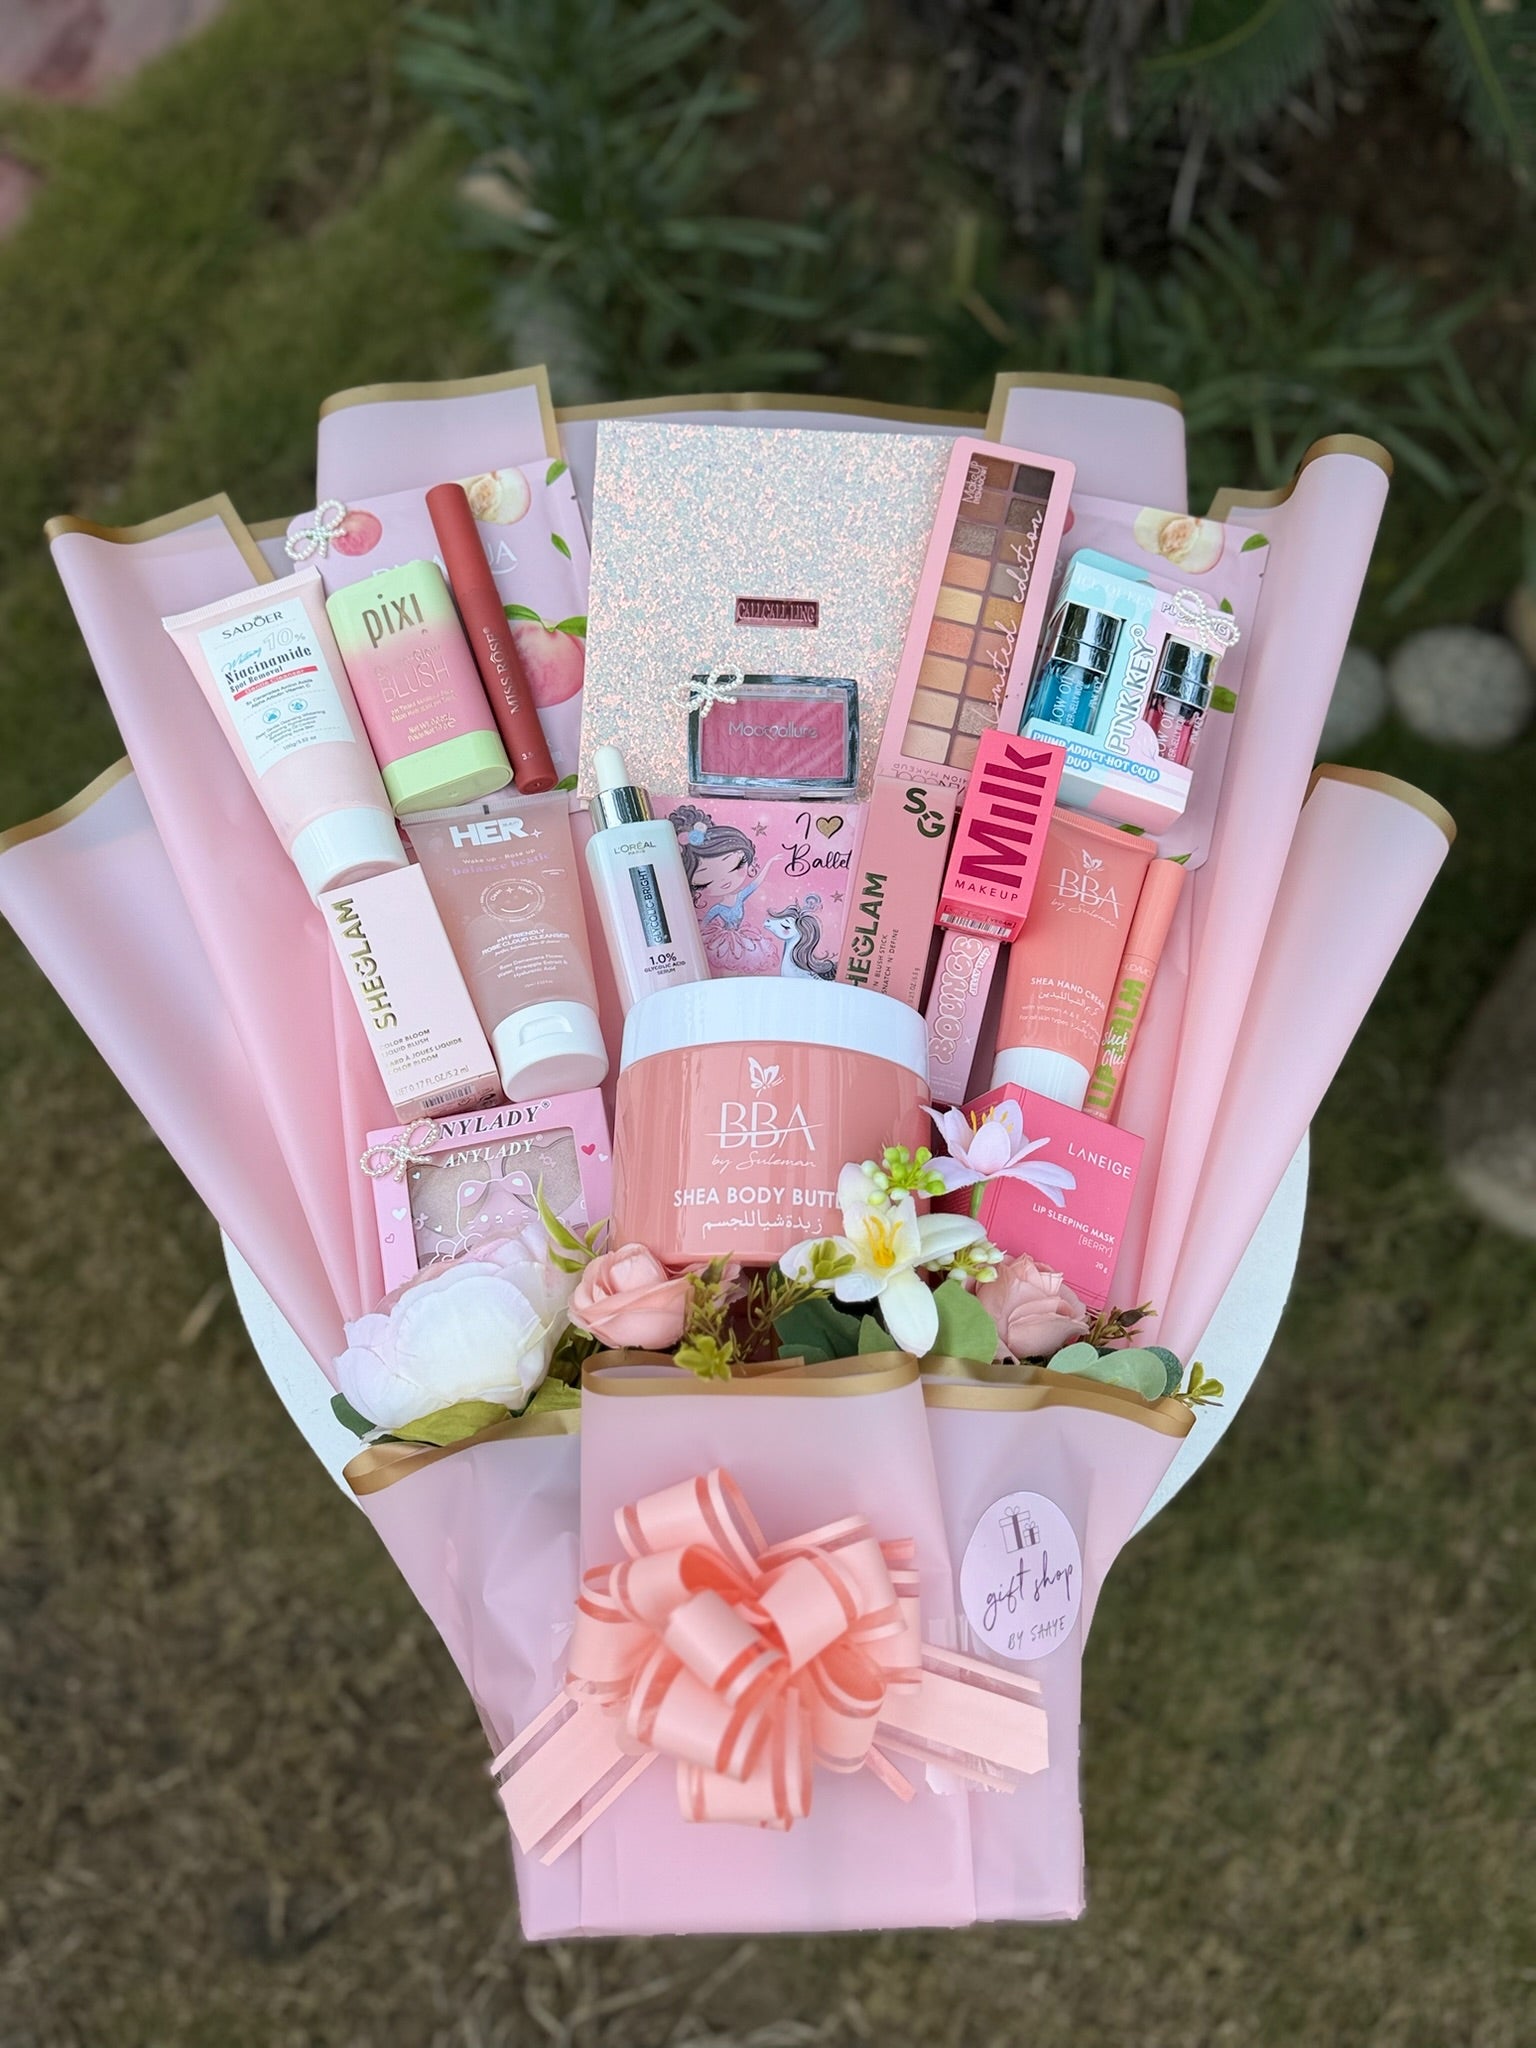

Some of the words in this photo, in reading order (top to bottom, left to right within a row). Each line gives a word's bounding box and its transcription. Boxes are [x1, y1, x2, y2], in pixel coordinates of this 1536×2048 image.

[1013, 510, 1042, 604] edition
[224, 646, 312, 686] Niacinamide
[378, 656, 450, 703] BLUSH
[499, 676, 520, 715] MISS
[1106, 691, 1143, 753] PINK
[1125, 637, 1156, 690] KEY
[1066, 756, 1090, 772] DUO
[1131, 761, 1159, 783] COLD
[448, 816, 529, 848] HER
[795, 811, 811, 840] I
[958, 743, 1053, 889] Milk
[781, 843, 853, 877] Ballet
[954, 879, 1018, 901] MAKEUP
[1056, 867, 1121, 919] BBA
[845, 872, 888, 987] HEGLAM
[878, 934, 888, 954] STICK
[889, 928, 899, 954] DEFINE
[331, 897, 398, 1032] SHEGLAM
[644, 962, 671, 973] GLYCOLIC
[649, 952, 677, 966] 1.0%
[1031, 977, 1054, 986] SHEA
[1057, 980, 1084, 994] HAND
[404, 1029, 430, 1041] BLOOM
[719, 1101, 816, 1151] BBA
[443, 1138, 534, 1169] ANYLADY
[711, 1153, 733, 1174] by
[1067, 1142, 1132, 1180] LANEIGE
[673, 1187, 720, 1208] SHEA
[727, 1186, 786, 1205] BODY
[1032, 1203, 1046, 1215] LIP
[1047, 1209, 1090, 1233] SLEEPING
[1090, 1225, 1116, 1245] MASK
[983, 1556, 1031, 1632] gift
[1033, 1550, 1073, 1601] shop
[1008, 1631, 1024, 1651] BY
